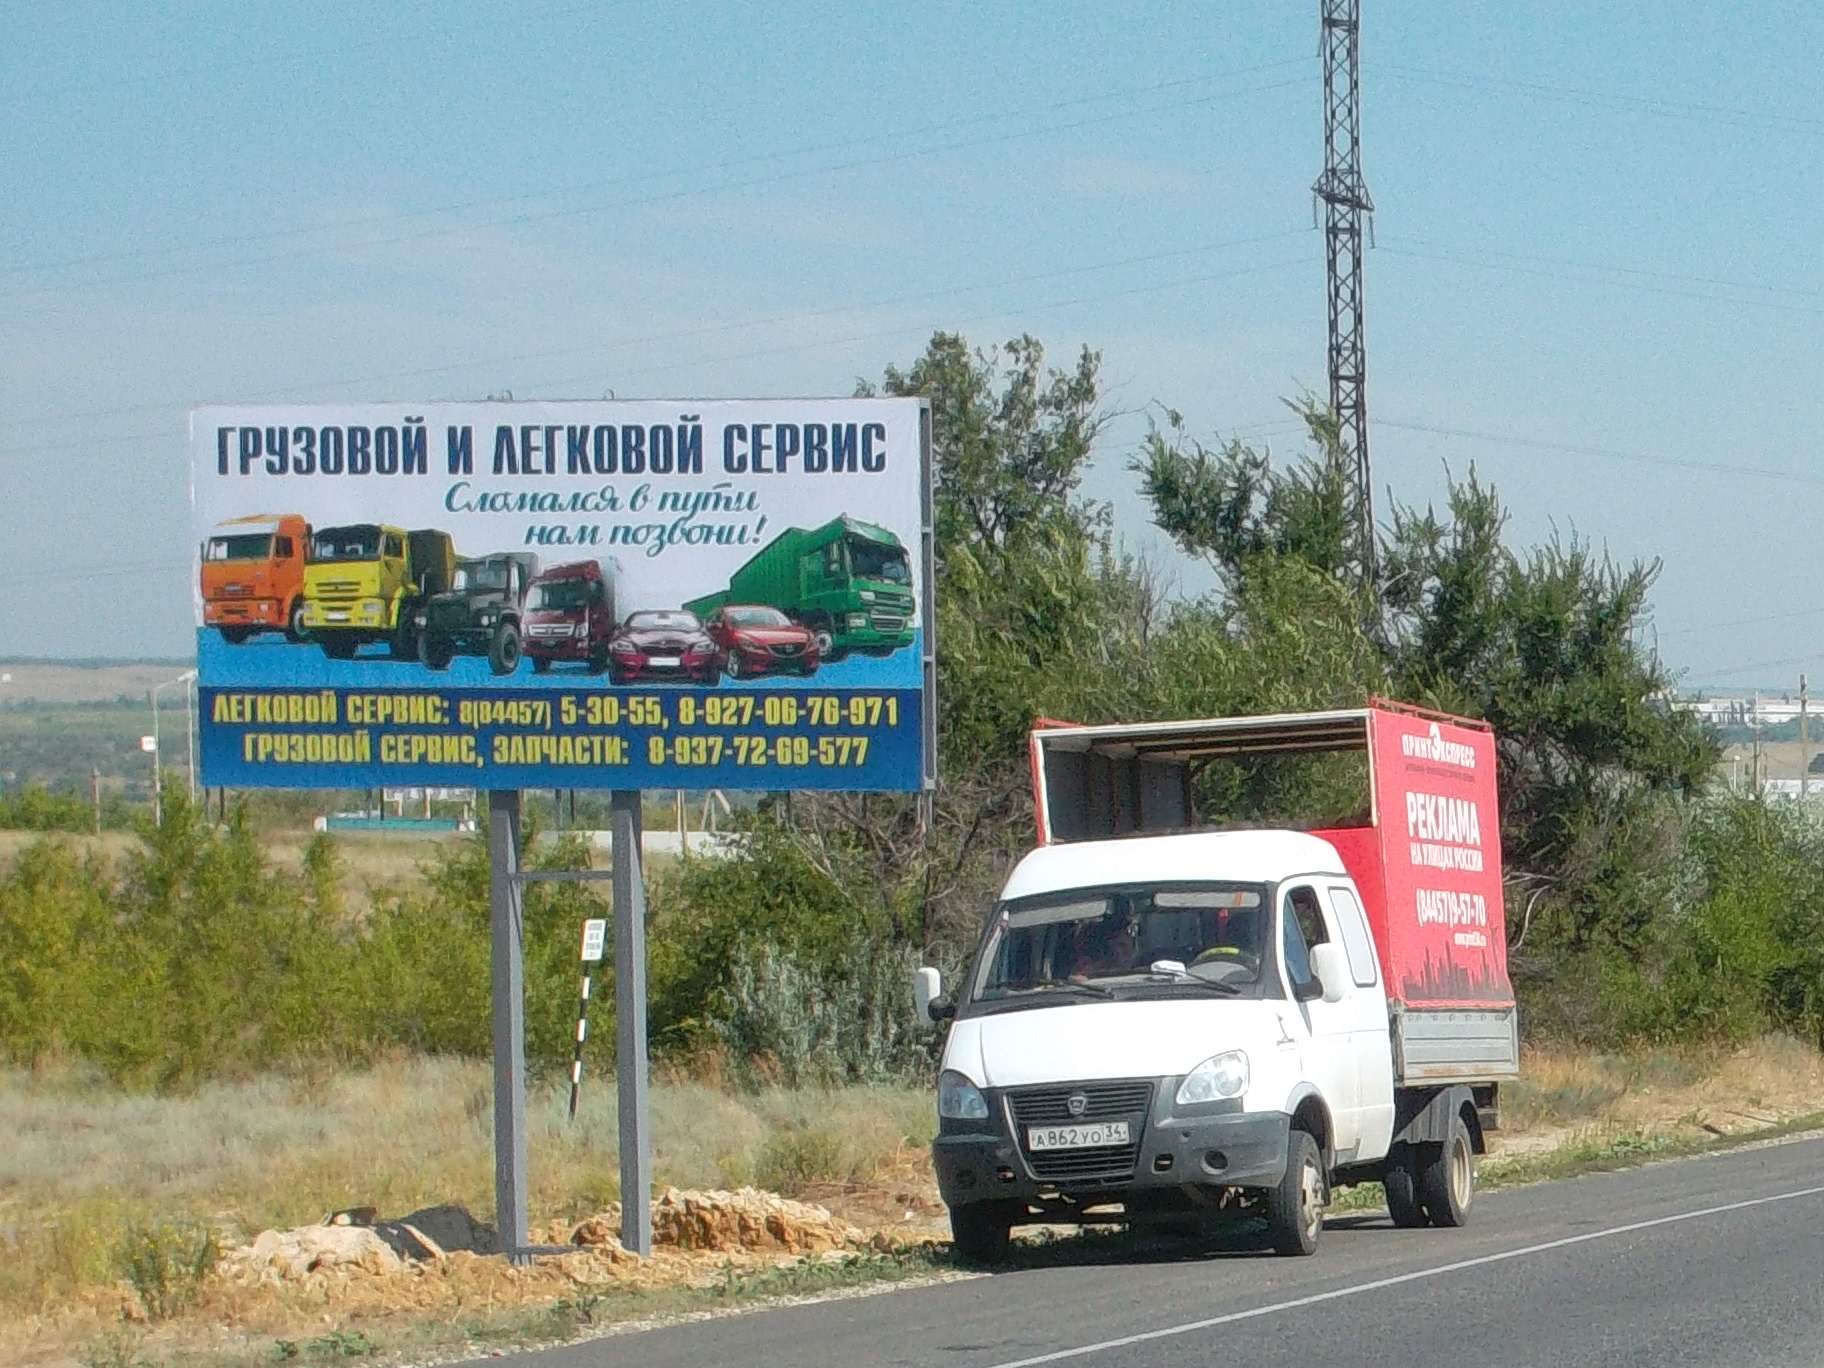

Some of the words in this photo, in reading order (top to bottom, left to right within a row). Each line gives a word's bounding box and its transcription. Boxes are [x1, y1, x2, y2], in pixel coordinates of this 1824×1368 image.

[216, 415, 429, 476] ГРУЗОВОЙ
[446, 424, 474, 476] И
[491, 413, 704, 475] ЛЕГКОВОЙ
[723, 422, 887, 474] СЕРВИС
[444, 481, 624, 514] Сломался
[628, 483, 652, 513] в
[657, 482, 760, 520] пути
[523, 523, 602, 546] нам
[608, 513, 769, 558] позвони!
[212, 690, 338, 724] ЛЕГКОВОЙ
[346, 694, 450, 724] СЕРВИС:
[458, 700, 552, 730] 8(84457)
[560, 695, 669, 729] 5-30-55,
[678, 696, 898, 726] 8-927-06-76-971
[243, 729, 371, 763] ГРУЗОВОЙ
[380, 734, 484, 768] СЕРВИС,
[493, 735, 630, 765] ЗАПЧАСТИ:
[648, 736, 869, 766] 8-937-72-69-577
[1405, 791, 1481, 846] РЕКЛАМА
